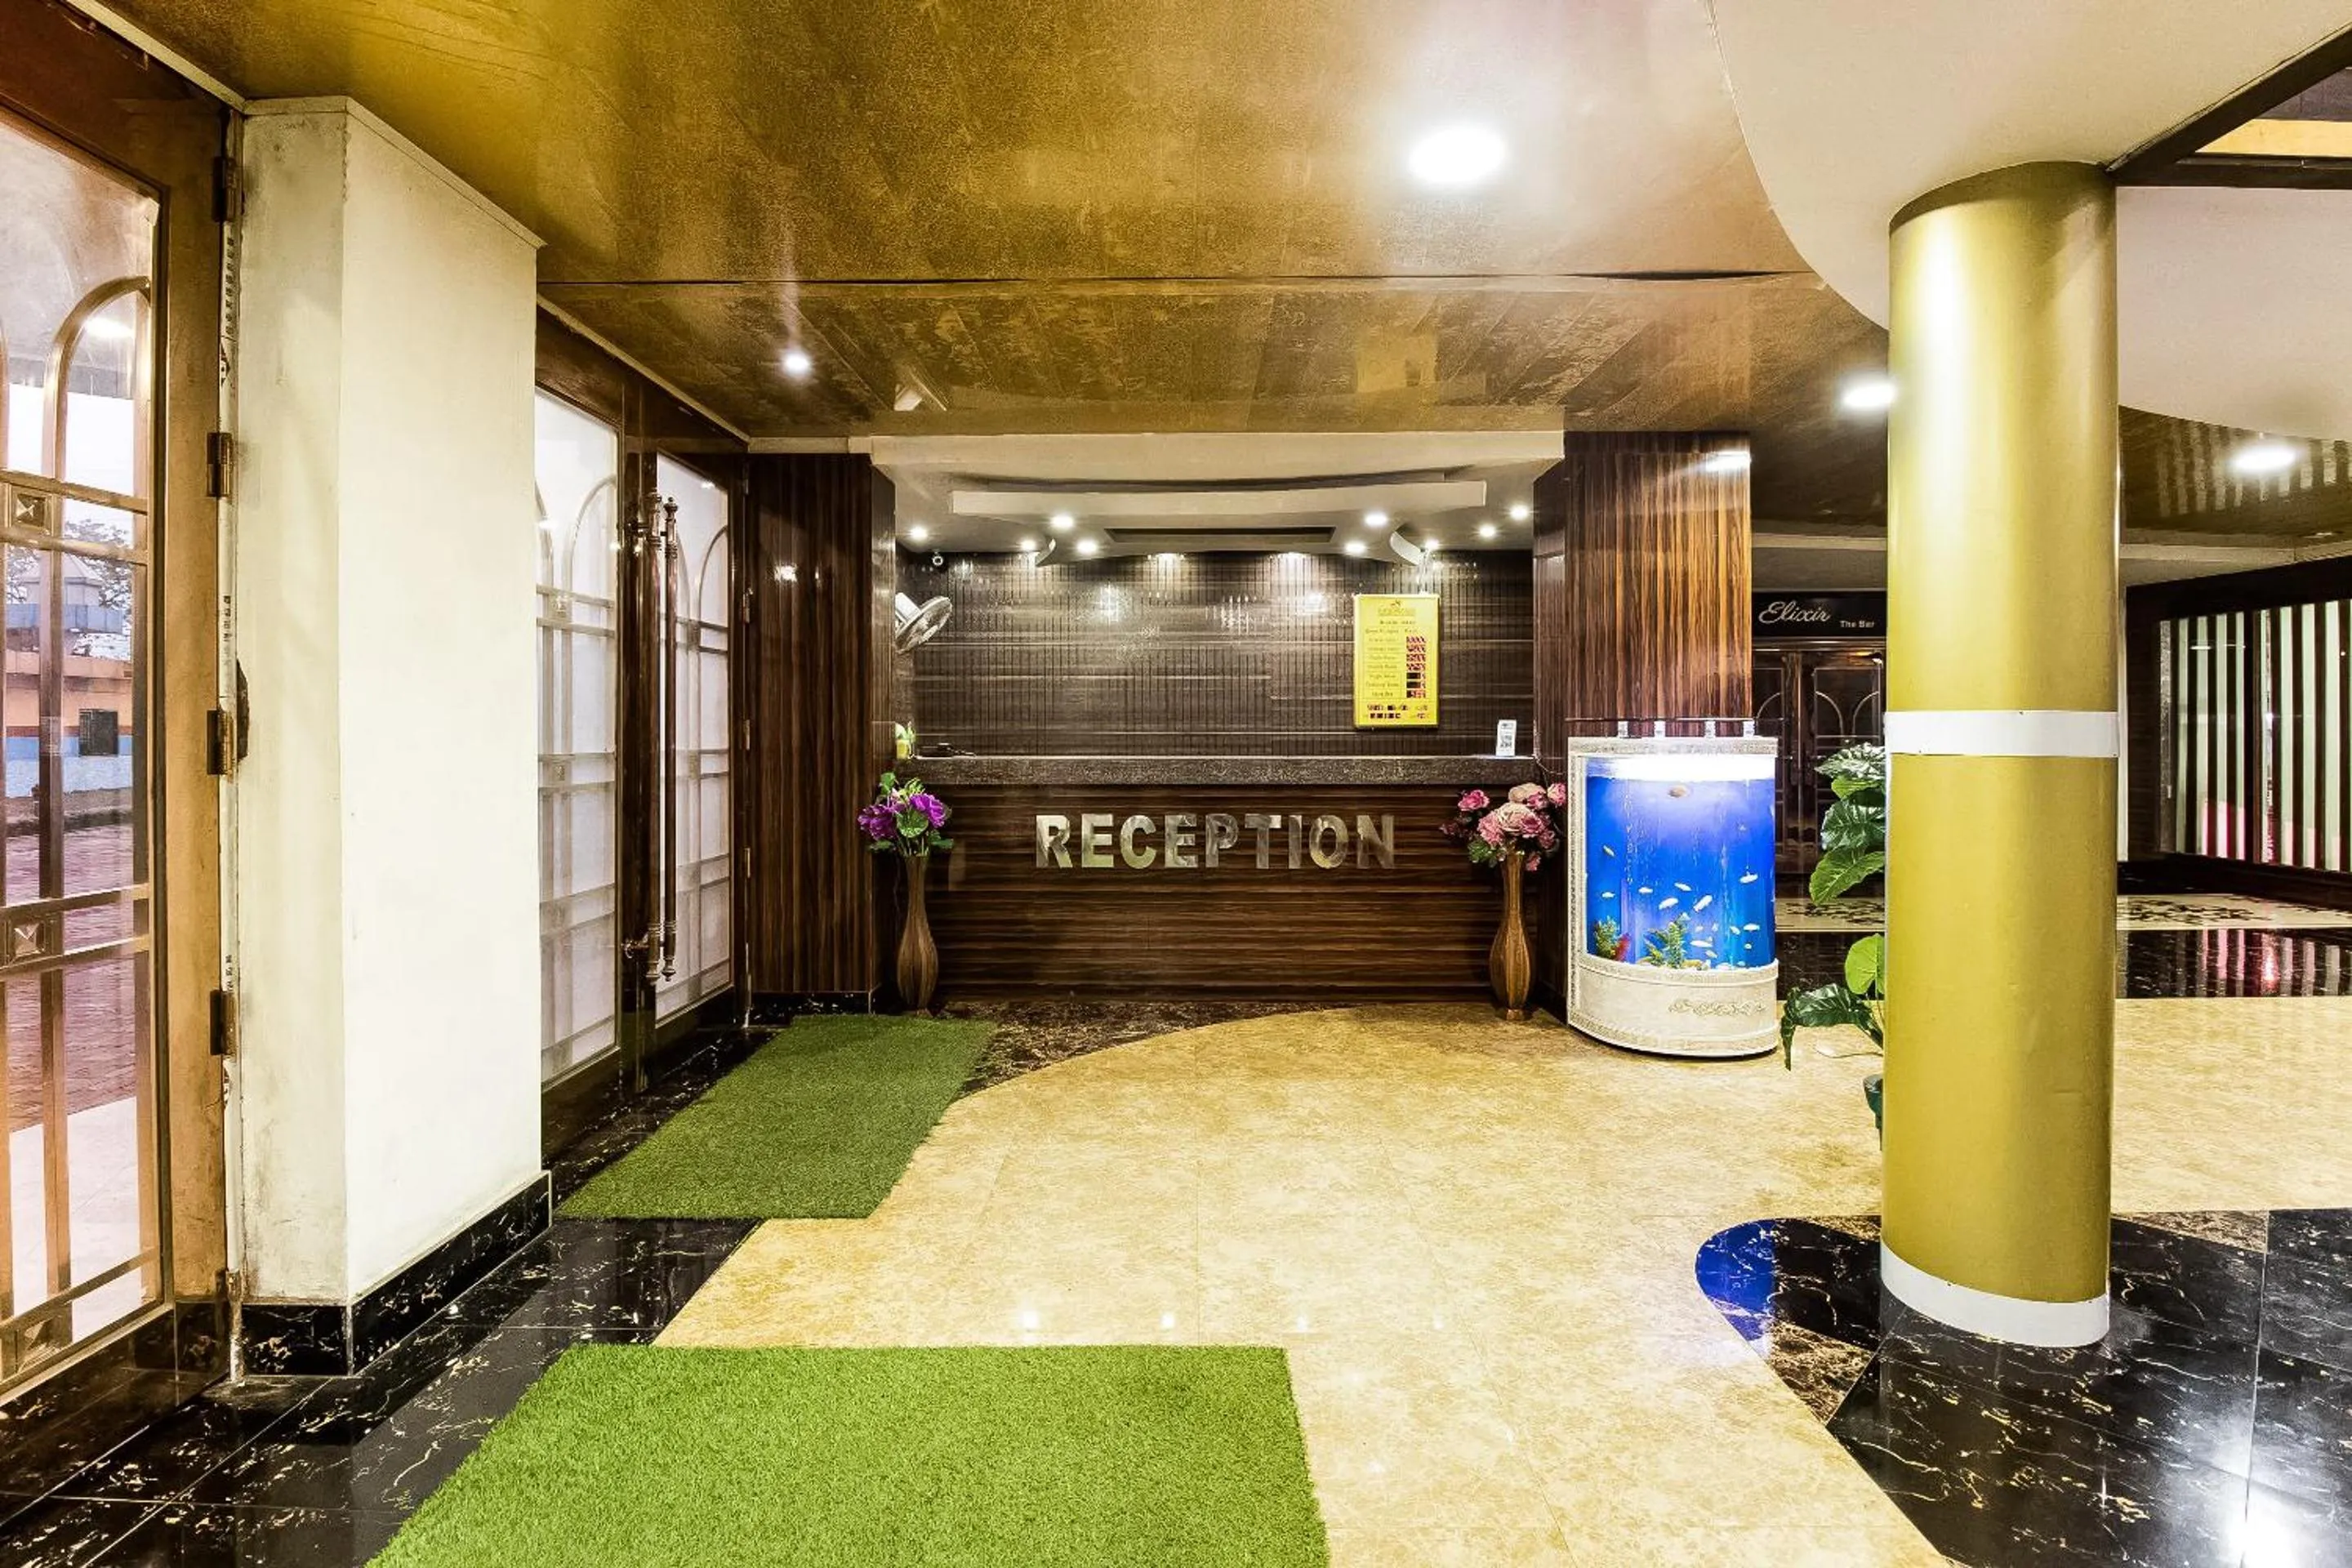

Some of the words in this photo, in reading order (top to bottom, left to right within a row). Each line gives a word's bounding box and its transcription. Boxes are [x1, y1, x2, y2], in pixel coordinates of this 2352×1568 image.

[1758, 599, 1831, 624] Elixir
[1840, 620, 1857, 628] The
[1859, 620, 1875, 628] Bar
[1036, 813, 1395, 870] RECEPTION
